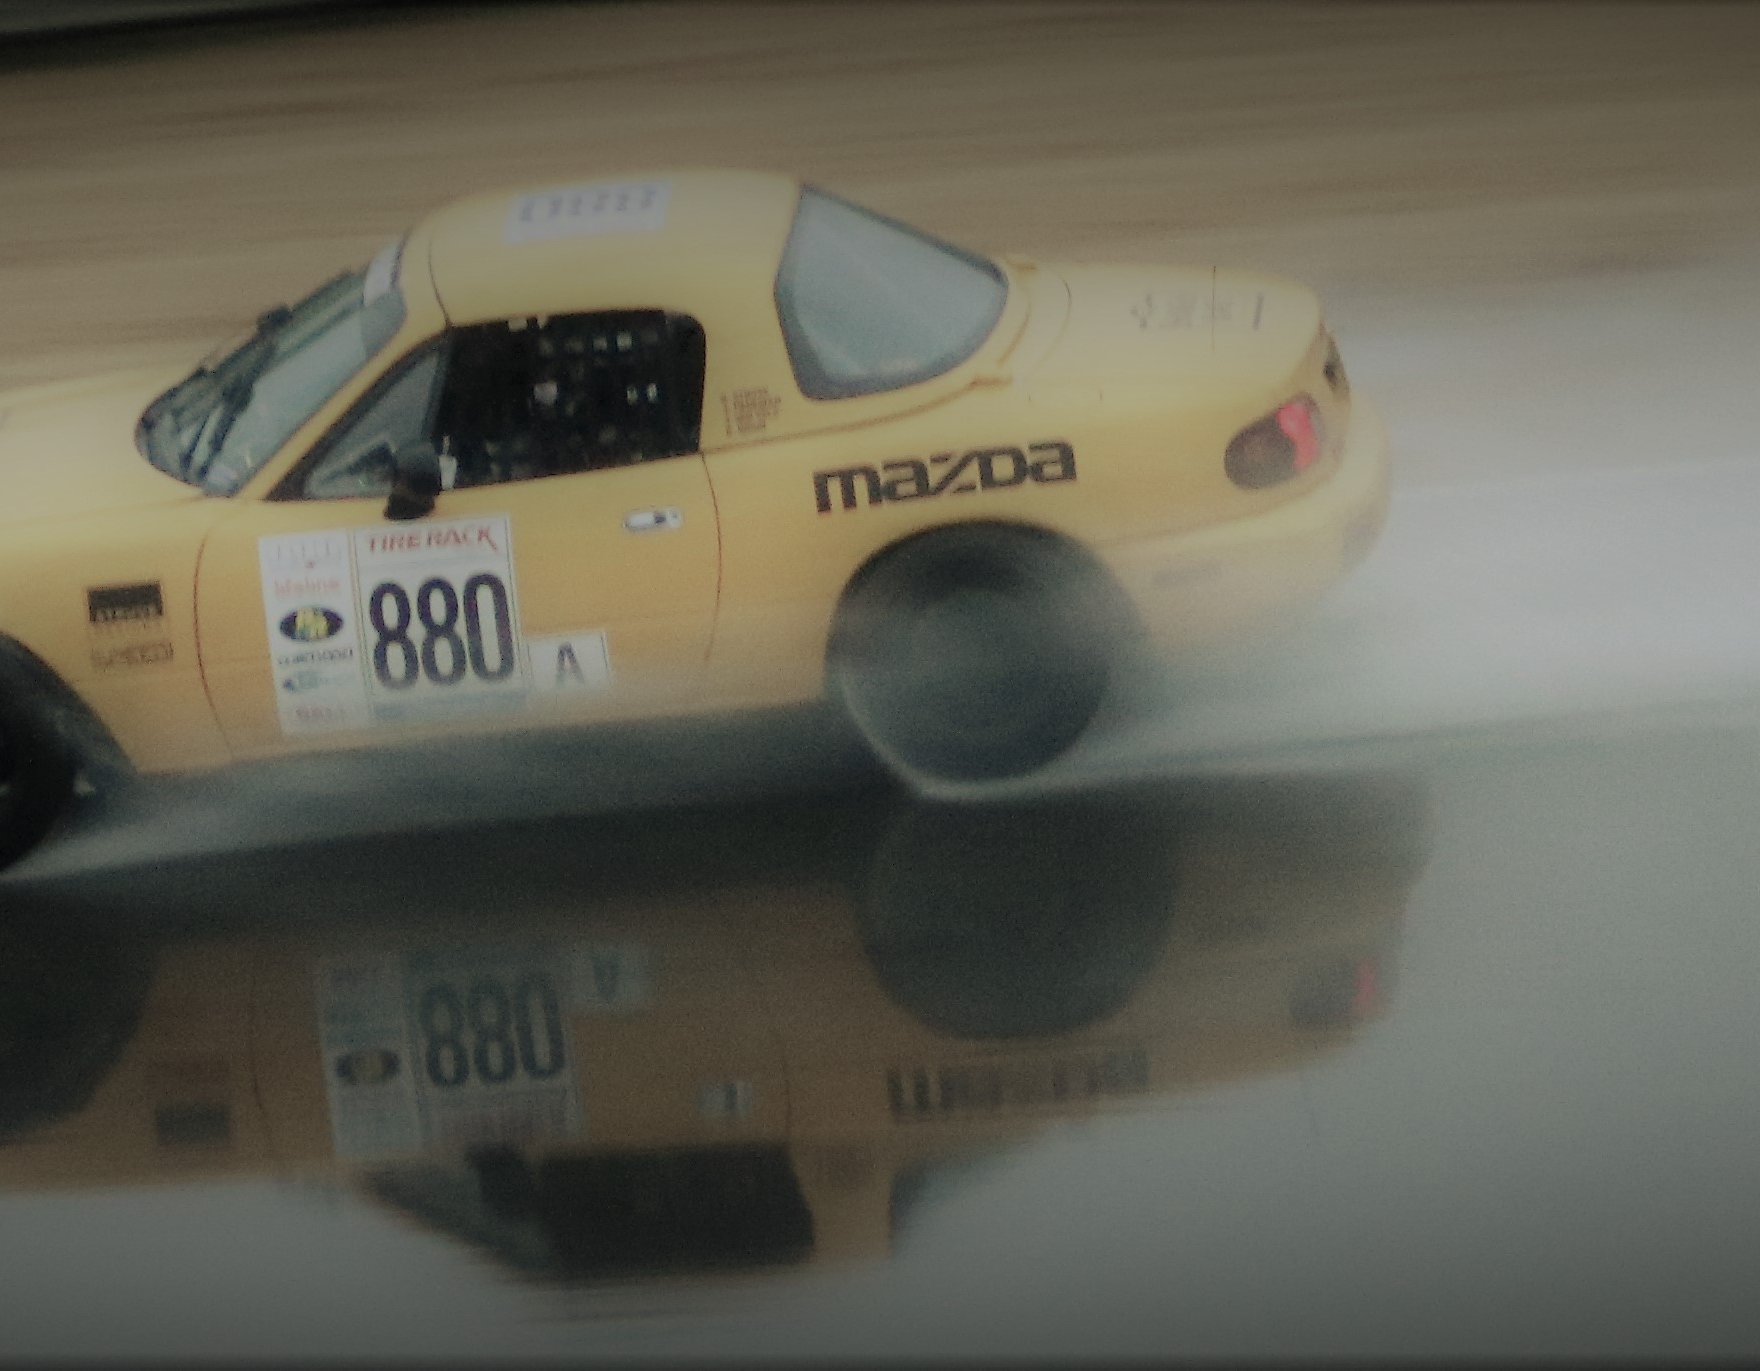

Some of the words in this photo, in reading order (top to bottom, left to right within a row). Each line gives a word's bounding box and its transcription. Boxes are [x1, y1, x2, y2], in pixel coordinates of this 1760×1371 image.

[813, 437, 1077, 513] mazda
[369, 573, 515, 690] 880
[555, 642, 586, 689] A
